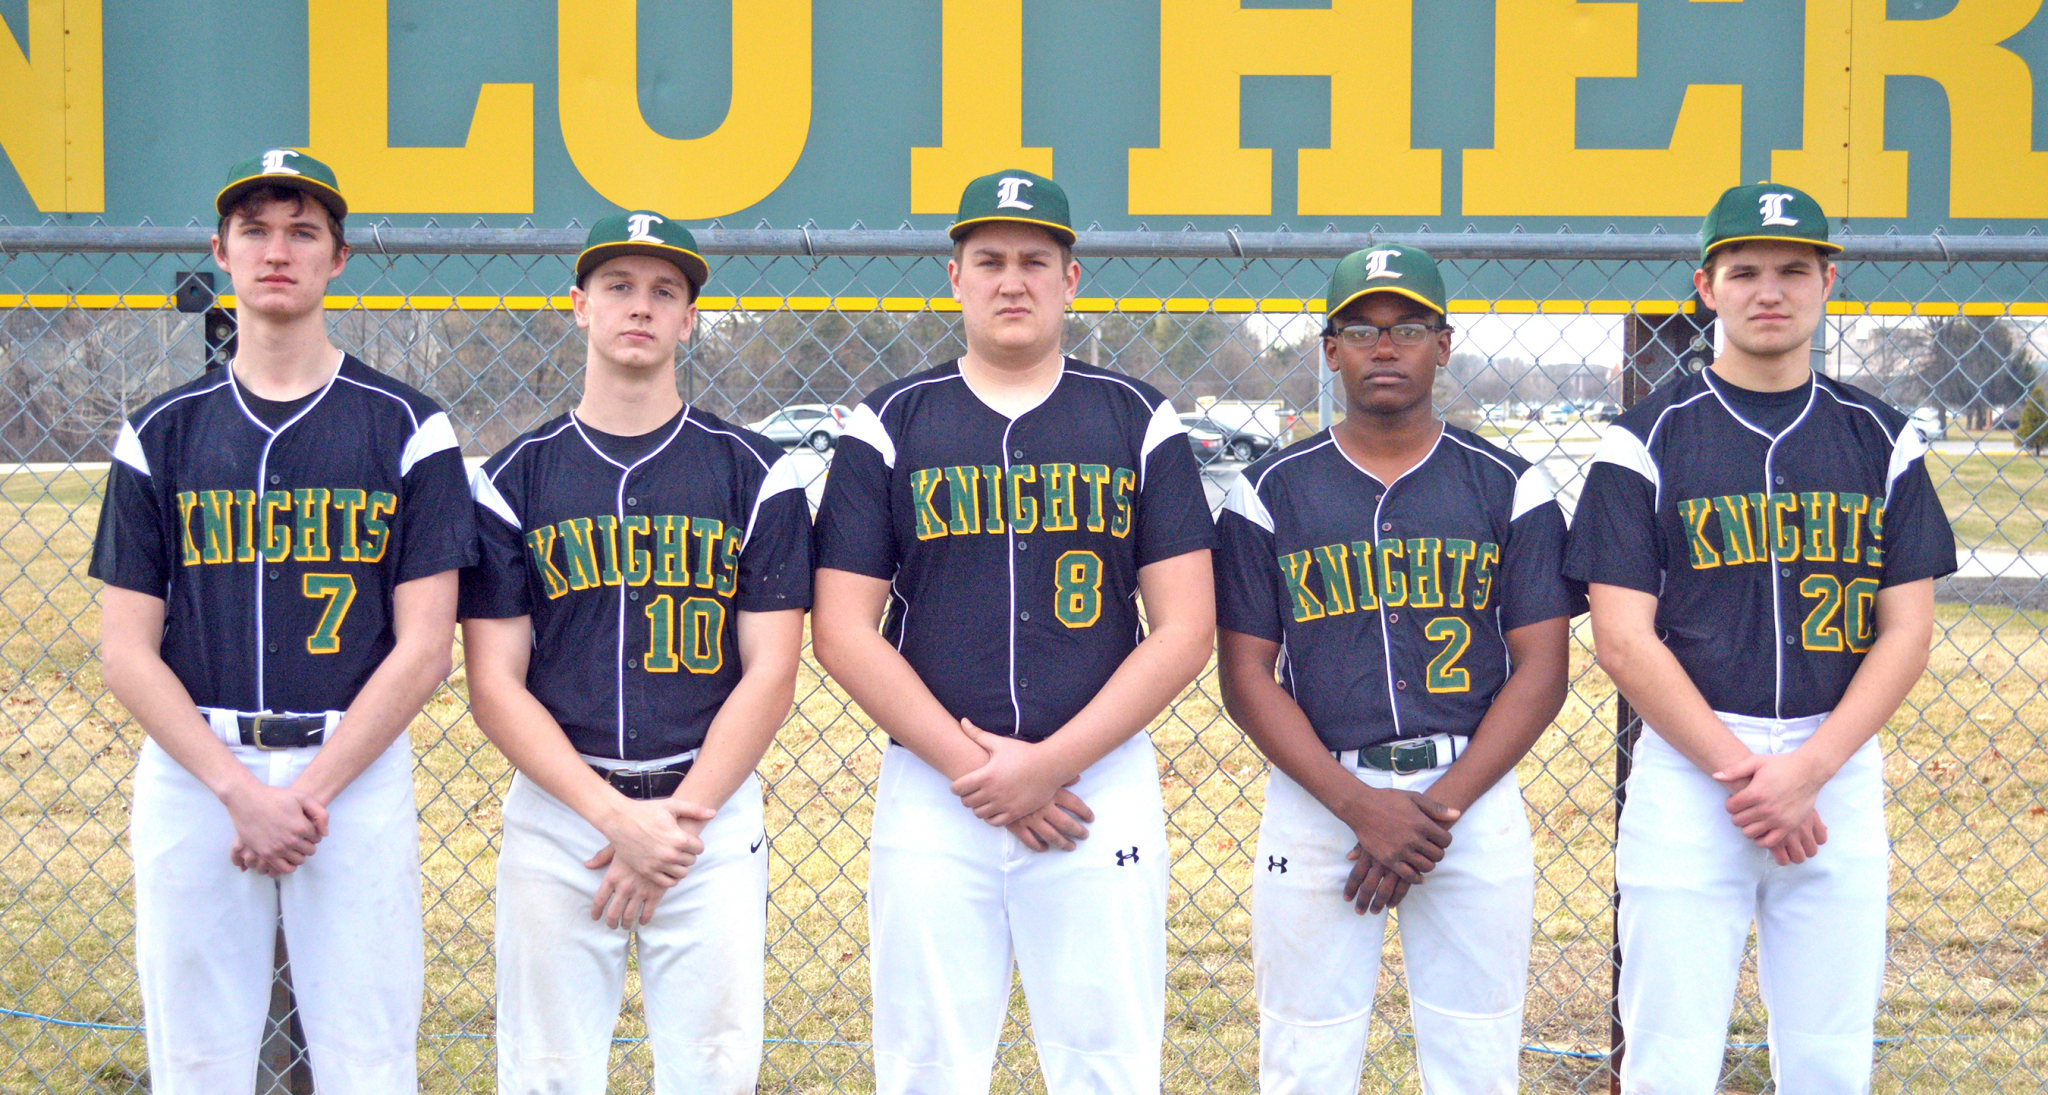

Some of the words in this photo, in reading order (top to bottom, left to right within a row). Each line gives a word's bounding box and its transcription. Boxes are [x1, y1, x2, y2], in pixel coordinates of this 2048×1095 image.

[262, 149, 301, 175] L
[997, 177, 1034, 210] L
[627, 213, 665, 244] L
[1759, 193, 1799, 227] L
[1365, 249, 1403, 281] L
[176, 488, 398, 566] KNIGHTS
[910, 463, 1136, 541] KNIGHTS
[525, 515, 743, 600] KNIGHTS
[1054, 550, 1104, 629] 8
[1278, 538, 1499, 623] KNIGHTS
[303, 573, 357, 655] 7
[644, 594, 725, 674] 10
[1800, 574, 1880, 653] 20
[1424, 616, 1471, 693] 2
